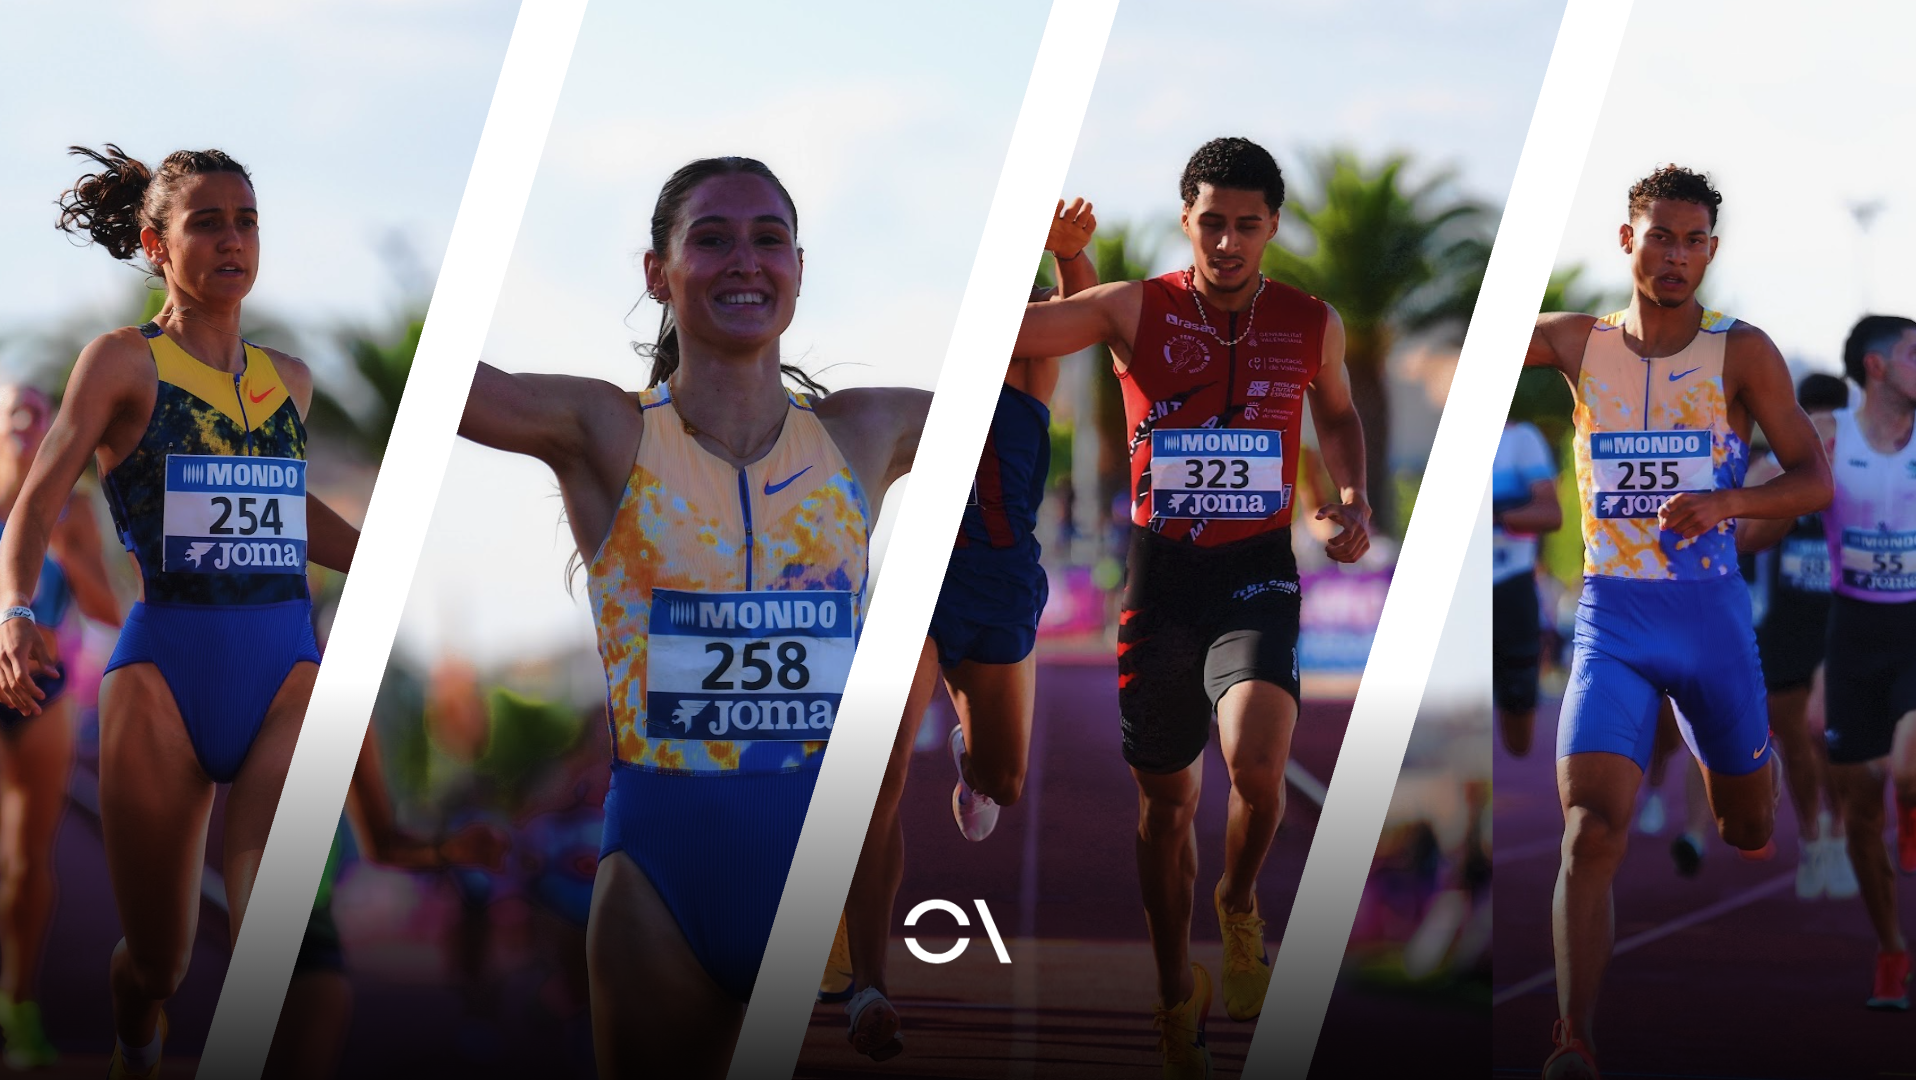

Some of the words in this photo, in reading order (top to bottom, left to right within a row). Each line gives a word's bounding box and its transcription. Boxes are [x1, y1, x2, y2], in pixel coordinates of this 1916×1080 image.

[1181, 434, 1269, 452] MONDO
[1614, 435, 1700, 454] MONDO
[206, 463, 298, 488] MONDO
[1184, 459, 1250, 489] 323
[1617, 461, 1680, 490] 255
[209, 496, 284, 536] 254
[1861, 537, 1916, 549] MOND
[1873, 554, 1903, 574] 55
[700, 600, 837, 629] MONDO
[701, 641, 810, 690] 258
